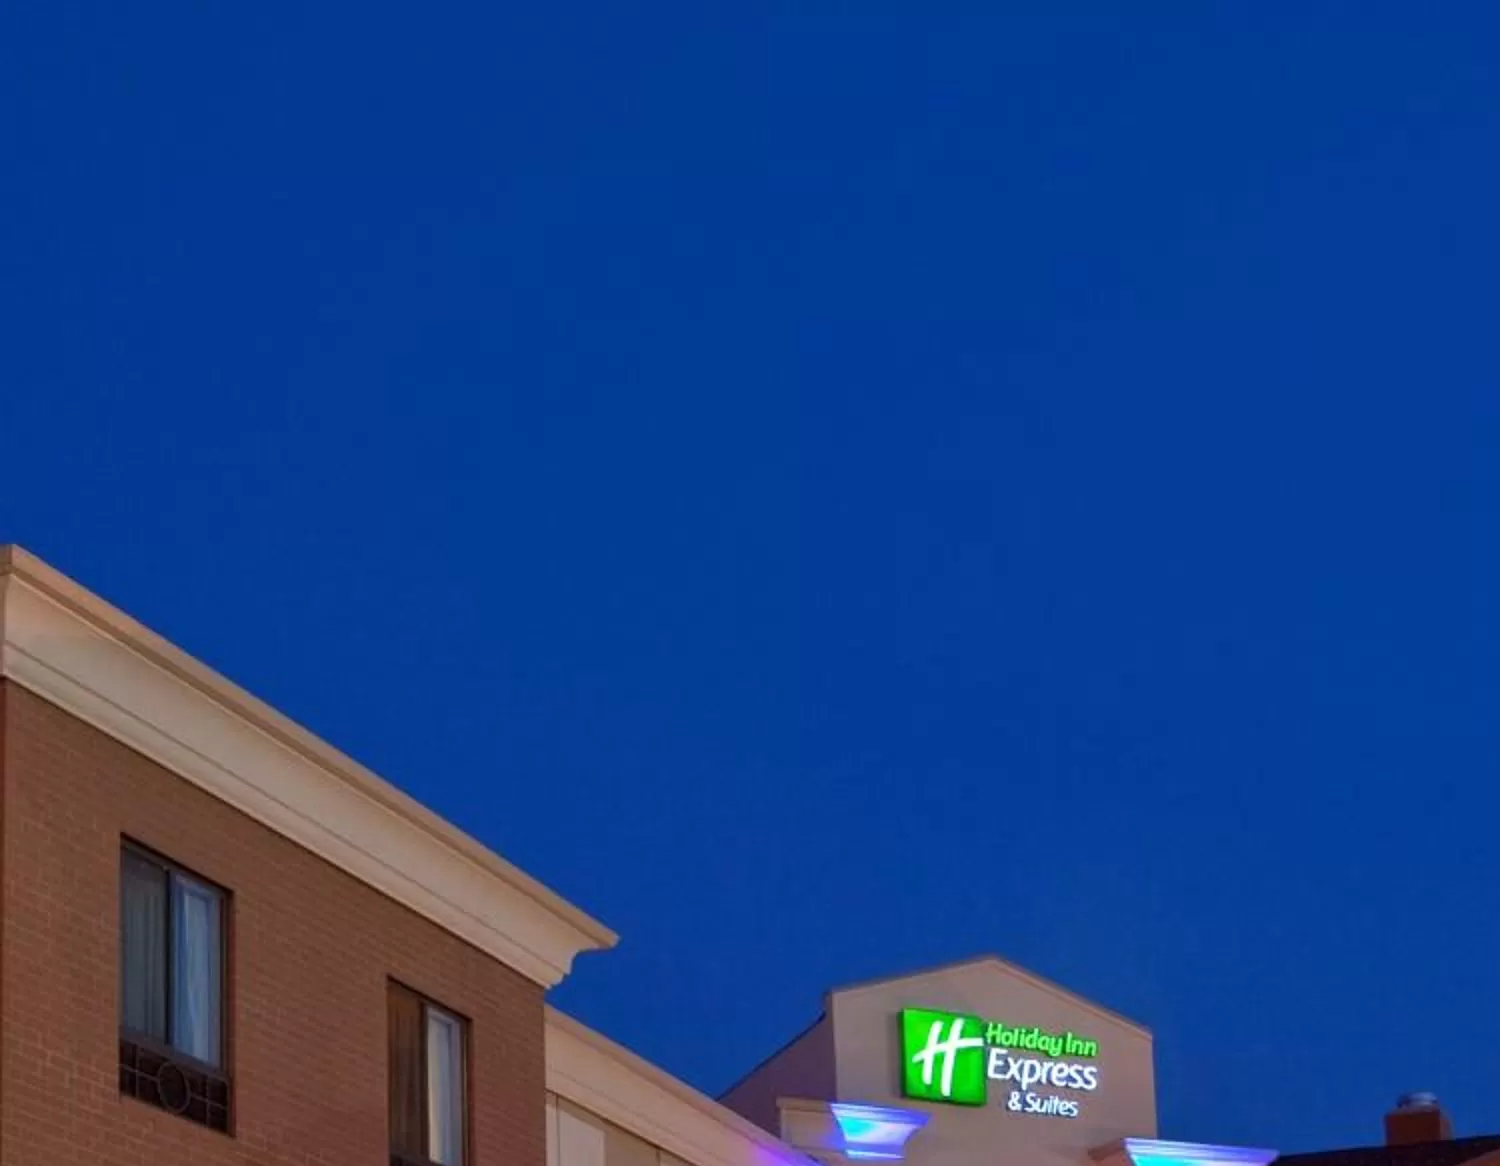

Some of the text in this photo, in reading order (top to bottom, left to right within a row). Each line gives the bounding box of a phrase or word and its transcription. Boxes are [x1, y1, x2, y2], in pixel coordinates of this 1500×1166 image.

[912, 1018, 984, 1097] H
[986, 1021, 1098, 1057] Holiday Inn
[987, 1047, 1098, 1091] Express
[1007, 1091, 1079, 1117] & Suites
